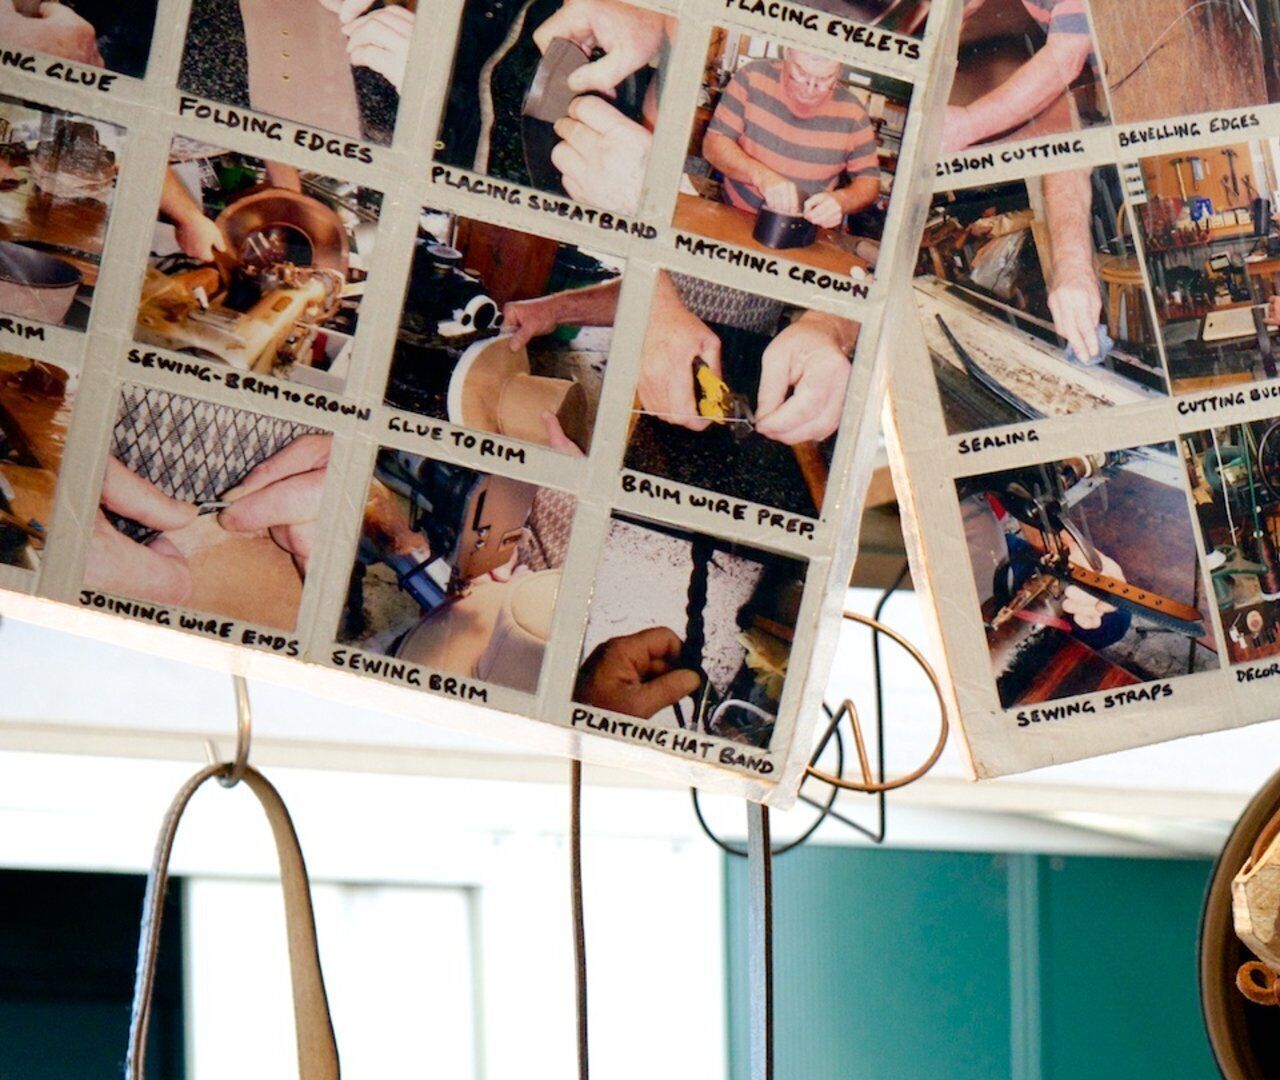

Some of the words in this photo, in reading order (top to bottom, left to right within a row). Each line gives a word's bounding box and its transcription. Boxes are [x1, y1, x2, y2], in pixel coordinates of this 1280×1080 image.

[827, 20, 920, 60] EYELETS
[0, 48, 36, 73] NG
[45, 62, 118, 92] GLUE
[179, 97, 282, 141] FOLDING
[293, 130, 374, 165] EDGES
[1001, 140, 1085, 163] CUTTING
[1118, 122, 1201, 148] BEVELLING
[1209, 114, 1260, 134] EDGES
[431, 166, 520, 206] PLACING
[528, 192, 658, 241] SWEATBAND
[675, 234, 779, 277] MATCHING
[788, 262, 868, 299] CROWN
[283, 389, 301, 404] TO
[303, 393, 372, 422] CROWN
[1177, 391, 1245, 416] CUTTING
[388, 416, 443, 441] GLUE
[450, 431, 476, 449] TO
[480, 439, 526, 464] RIM
[958, 429, 1040, 455] SEALING
[621, 474, 682, 505] BRIM
[689, 494, 746, 522] WIRE
[79, 589, 171, 627] JOINING
[179, 612, 233, 639] WIRE
[241, 629, 300, 657] ENDS
[331, 650, 422, 687] SEWING
[428, 674, 488, 703] BRIM
[1016, 700, 1096, 728] SEWING
[1103, 683, 1174, 709] STRAPS
[570, 708, 667, 746] PLAITING
[673, 733, 715, 757] HAT
[718, 748, 775, 775] BAND
